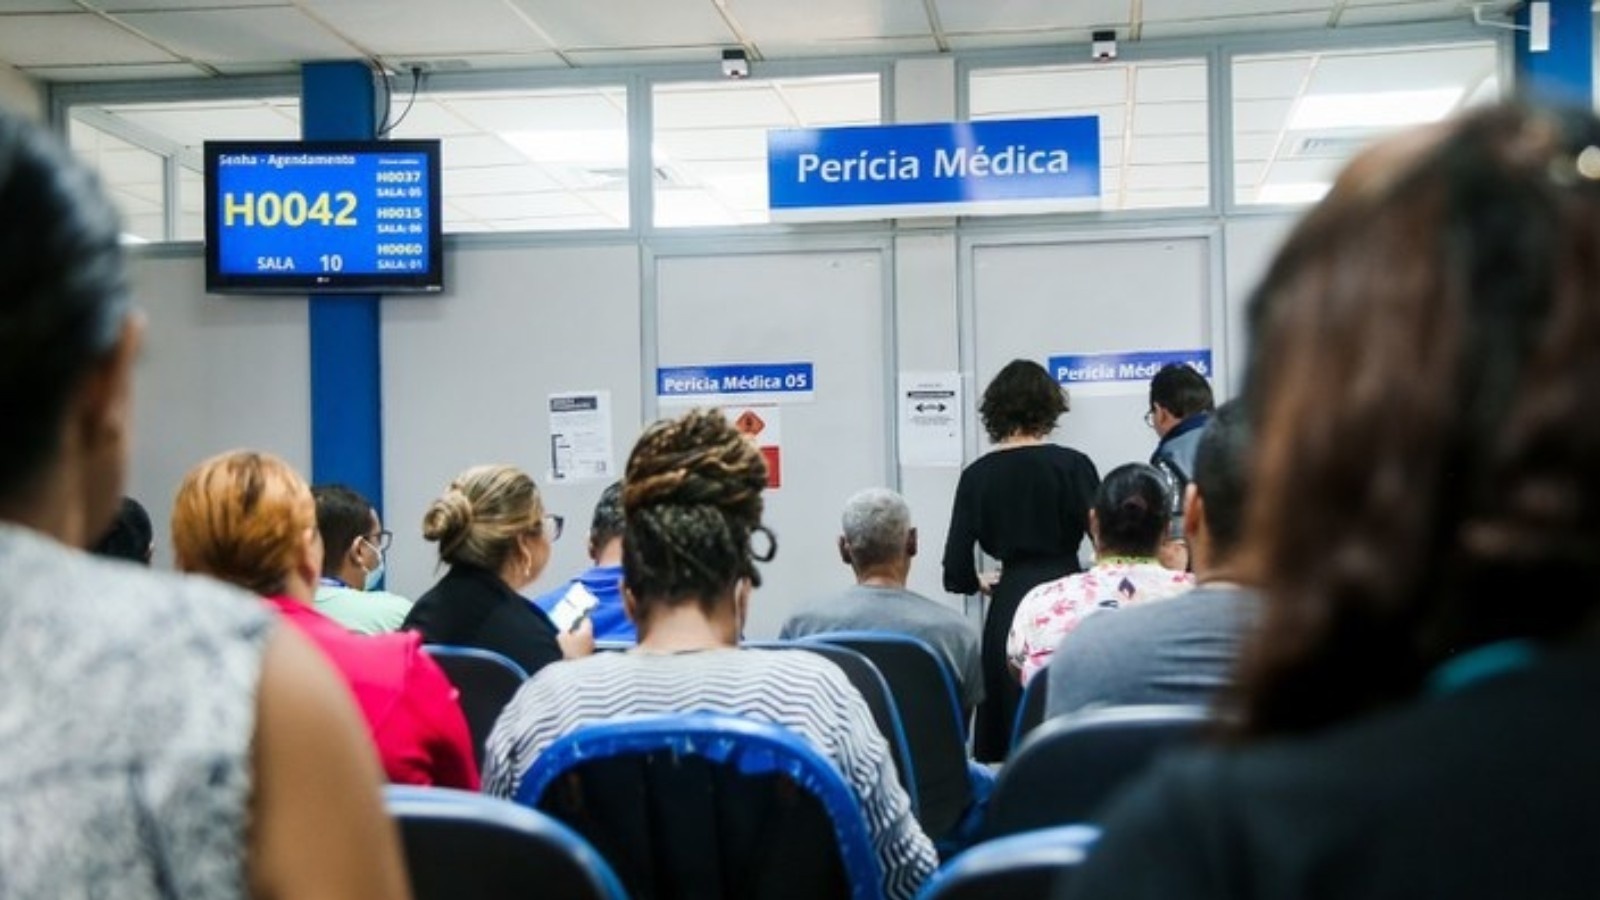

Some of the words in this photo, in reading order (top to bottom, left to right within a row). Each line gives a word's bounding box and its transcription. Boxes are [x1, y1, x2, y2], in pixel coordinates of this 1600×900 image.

[219, 154, 257, 165] Senha
[267, 153, 356, 168] Agendamento
[797, 150, 920, 184] Perícia
[934, 144, 1070, 178] Médica
[223, 190, 358, 227] H0042
[257, 256, 295, 270] SALA
[319, 254, 344, 272] 10
[723, 374, 782, 390] Médica
[784, 372, 807, 388] 05
